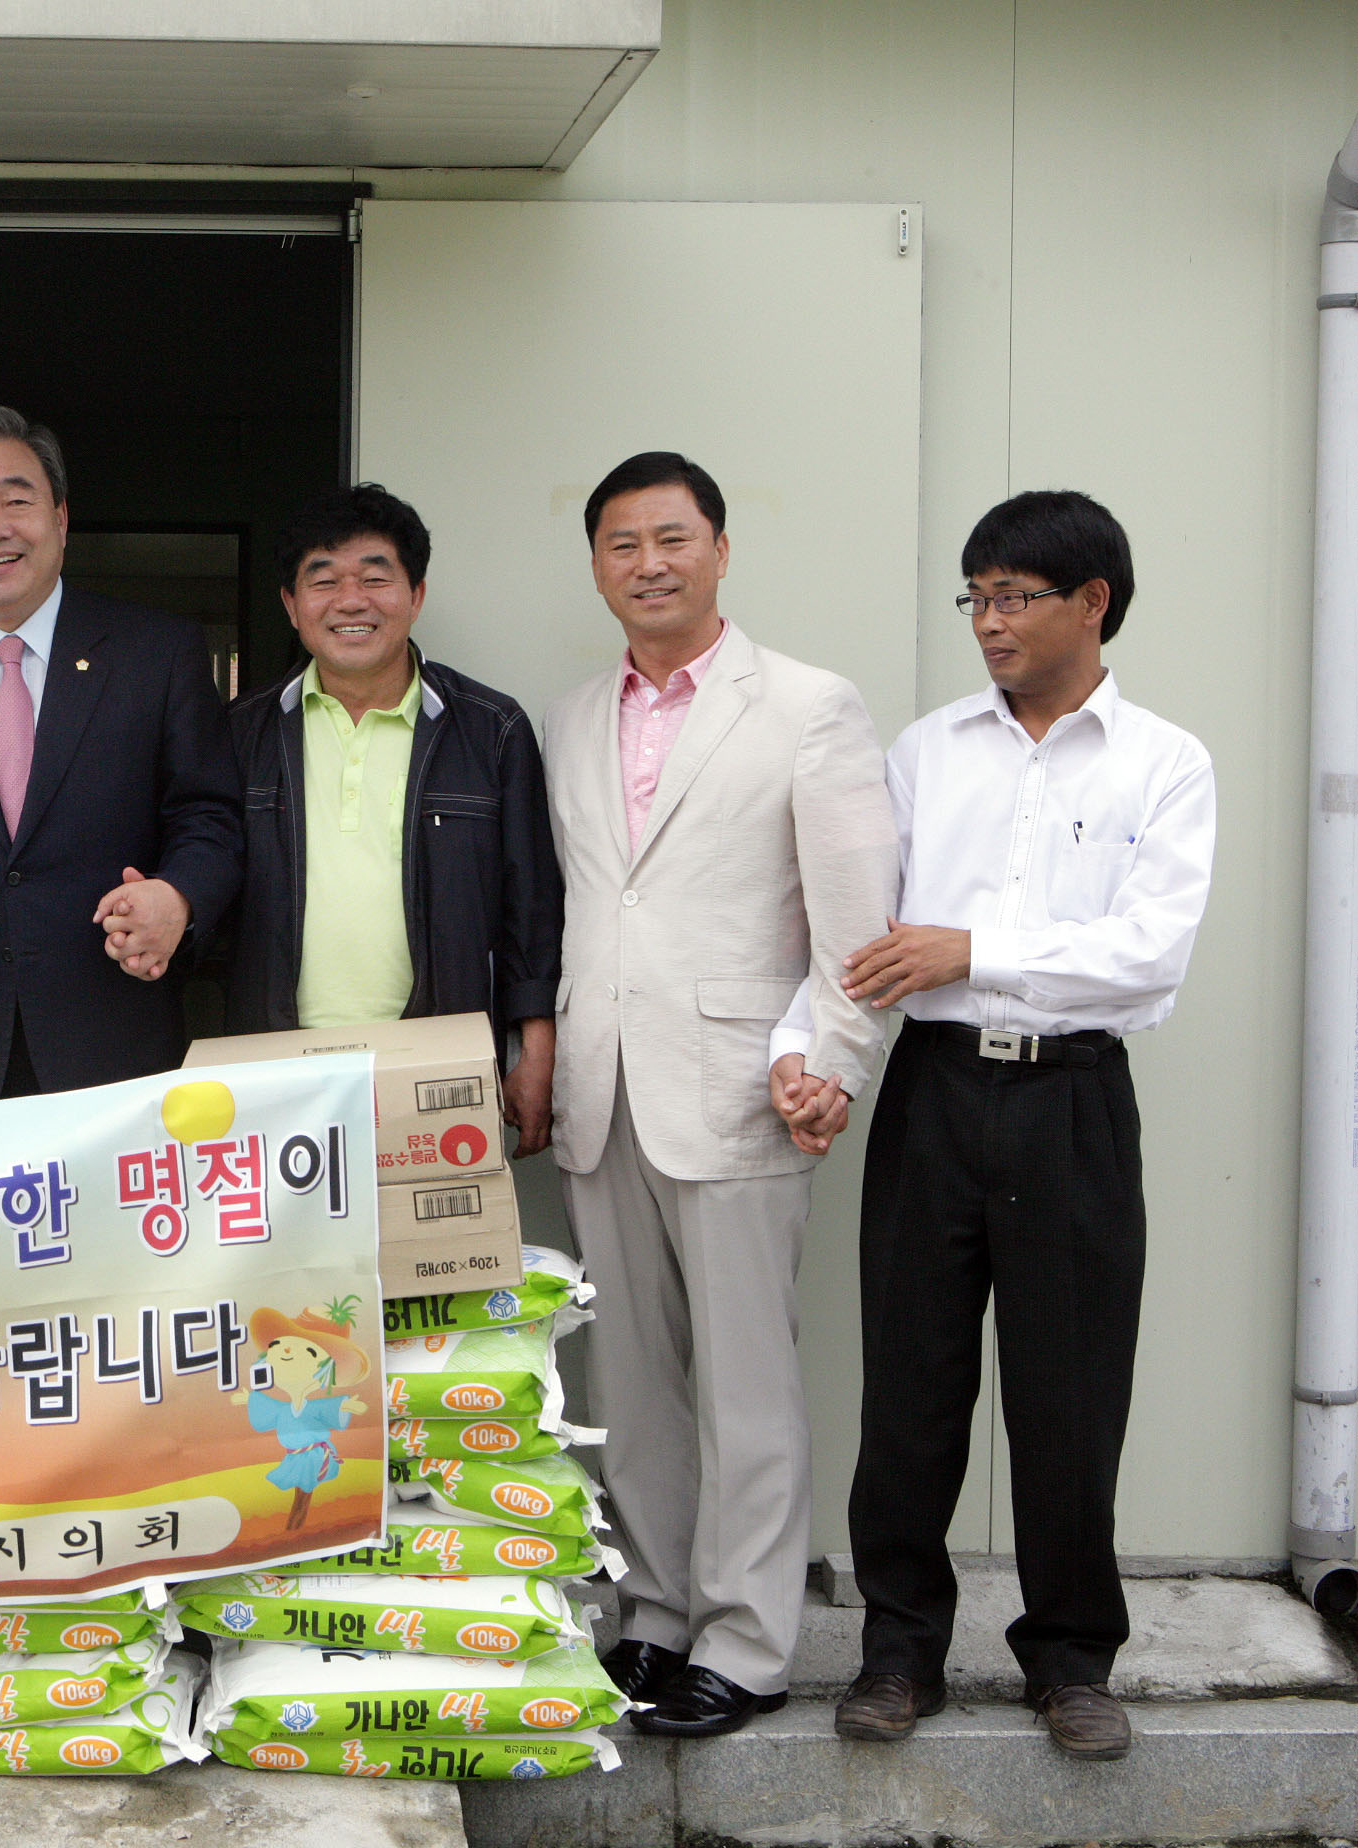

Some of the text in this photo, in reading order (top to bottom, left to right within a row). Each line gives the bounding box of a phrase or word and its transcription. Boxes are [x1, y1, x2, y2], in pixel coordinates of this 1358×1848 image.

[114, 1120, 348, 1257] 명절이
[452, 1391, 495, 1408] 10kg
[470, 1429, 510, 1447] 10kg
[501, 1487, 544, 1515] 10kg
[504, 1541, 548, 1562] 10kg
[69, 1629, 112, 1646] 10kg
[283, 1607, 512, 1651] 가나안 쌀 10kg
[57, 1680, 101, 1701] 10kg
[344, 1692, 574, 1733] 가나안 쌀 10kg
[68, 1745, 113, 1763] 10kg
[255, 1749, 298, 1768] 10kg
[398, 1745, 485, 1779] 가나안
